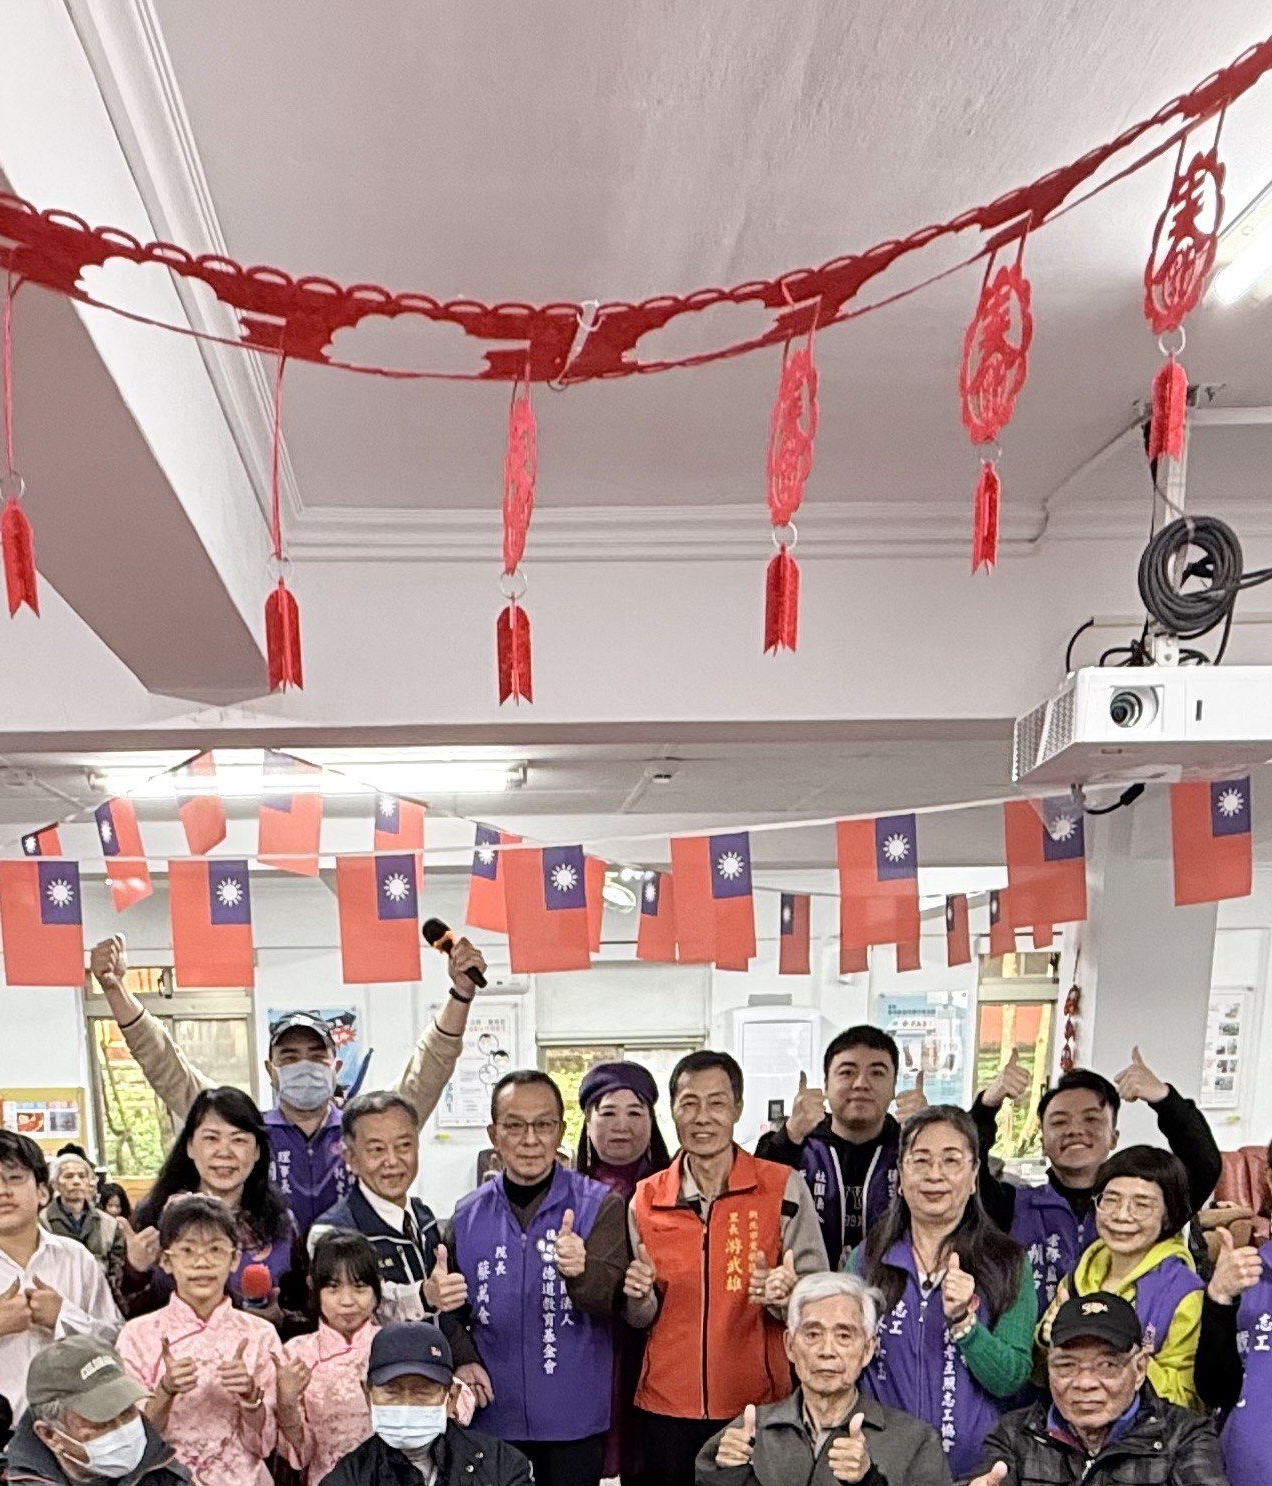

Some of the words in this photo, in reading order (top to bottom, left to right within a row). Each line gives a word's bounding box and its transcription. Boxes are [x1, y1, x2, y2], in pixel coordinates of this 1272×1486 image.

[277, 1150, 292, 1194] 理事長
[494, 1245, 508, 1276] 院長
[888, 1300, 908, 1335] 志工
